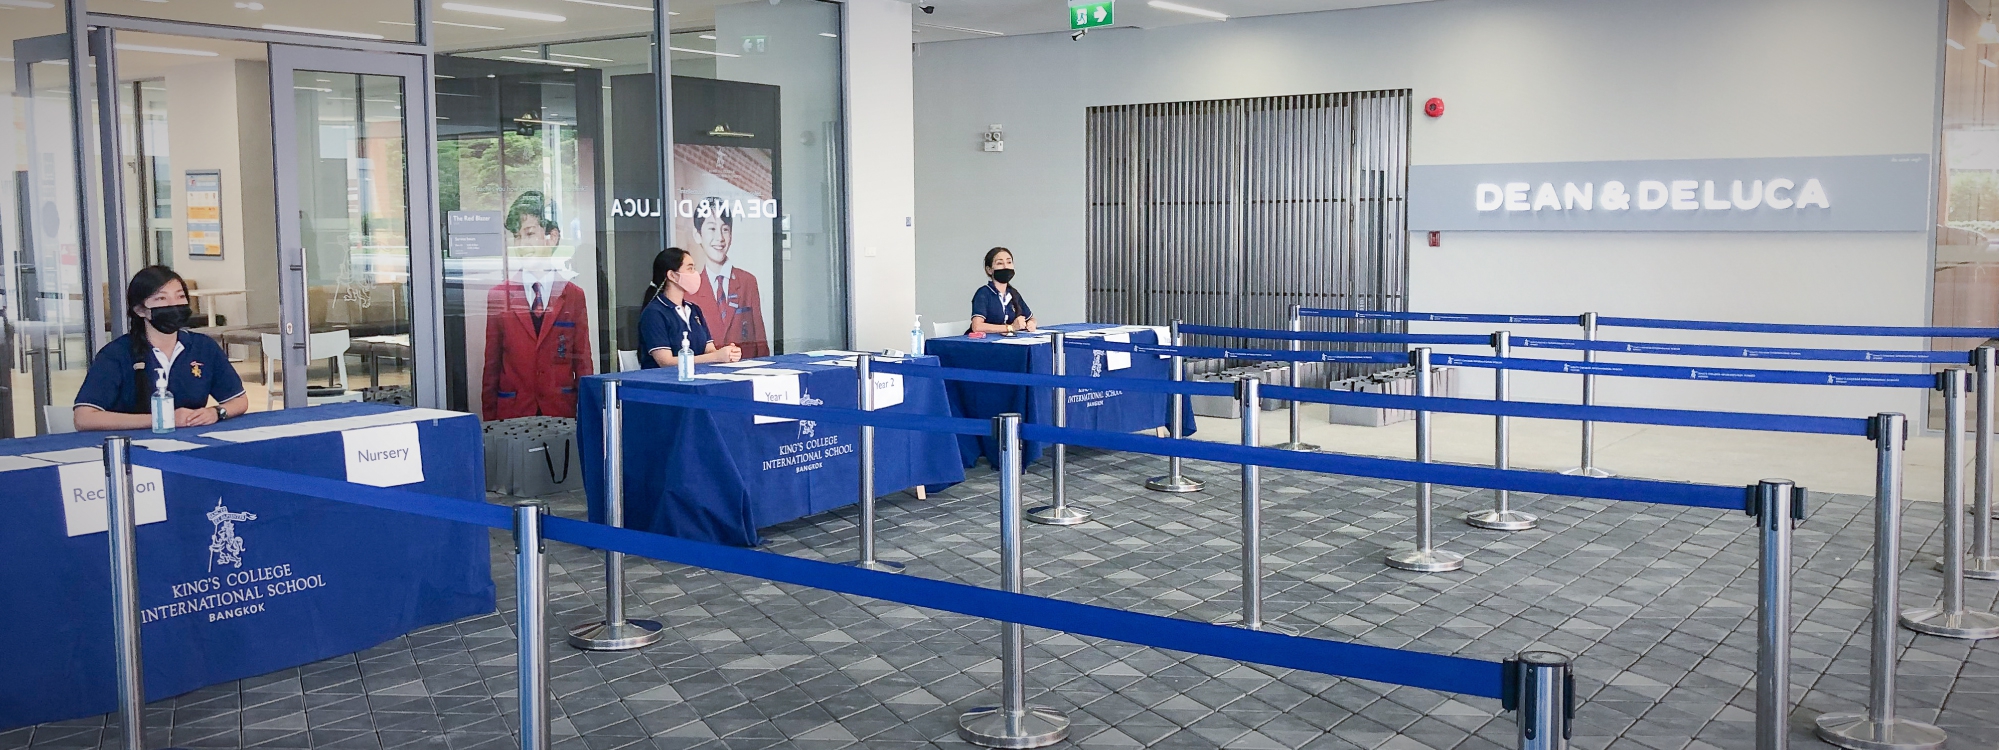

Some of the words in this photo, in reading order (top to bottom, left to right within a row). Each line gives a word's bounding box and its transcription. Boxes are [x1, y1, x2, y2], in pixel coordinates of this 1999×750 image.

[1476, 181, 1593, 212] DEAN
[1600, 180, 1631, 212] &
[1638, 178, 1831, 212] DELUCA
[875, 380, 889, 391] Year
[890, 377, 895, 387] 2
[765, 391, 782, 402] Year
[785, 390, 789, 401] 1
[357, 447, 409, 463] Nursery
[779, 441, 804, 456] KING'S
[806, 435, 838, 450] COLLEGE
[762, 450, 823, 471] INTERNATIONAL
[824, 443, 854, 458] SCHOOL
[795, 461, 823, 473] BANGKOK
[73, 481, 156, 503] Recon
[171, 576, 221, 599] KING'S
[226, 563, 293, 587] COLLEGE
[140, 586, 264, 624] INTERNATIONAL
[267, 574, 327, 597] SCHOOL
[208, 602, 266, 623] BANGKOK
